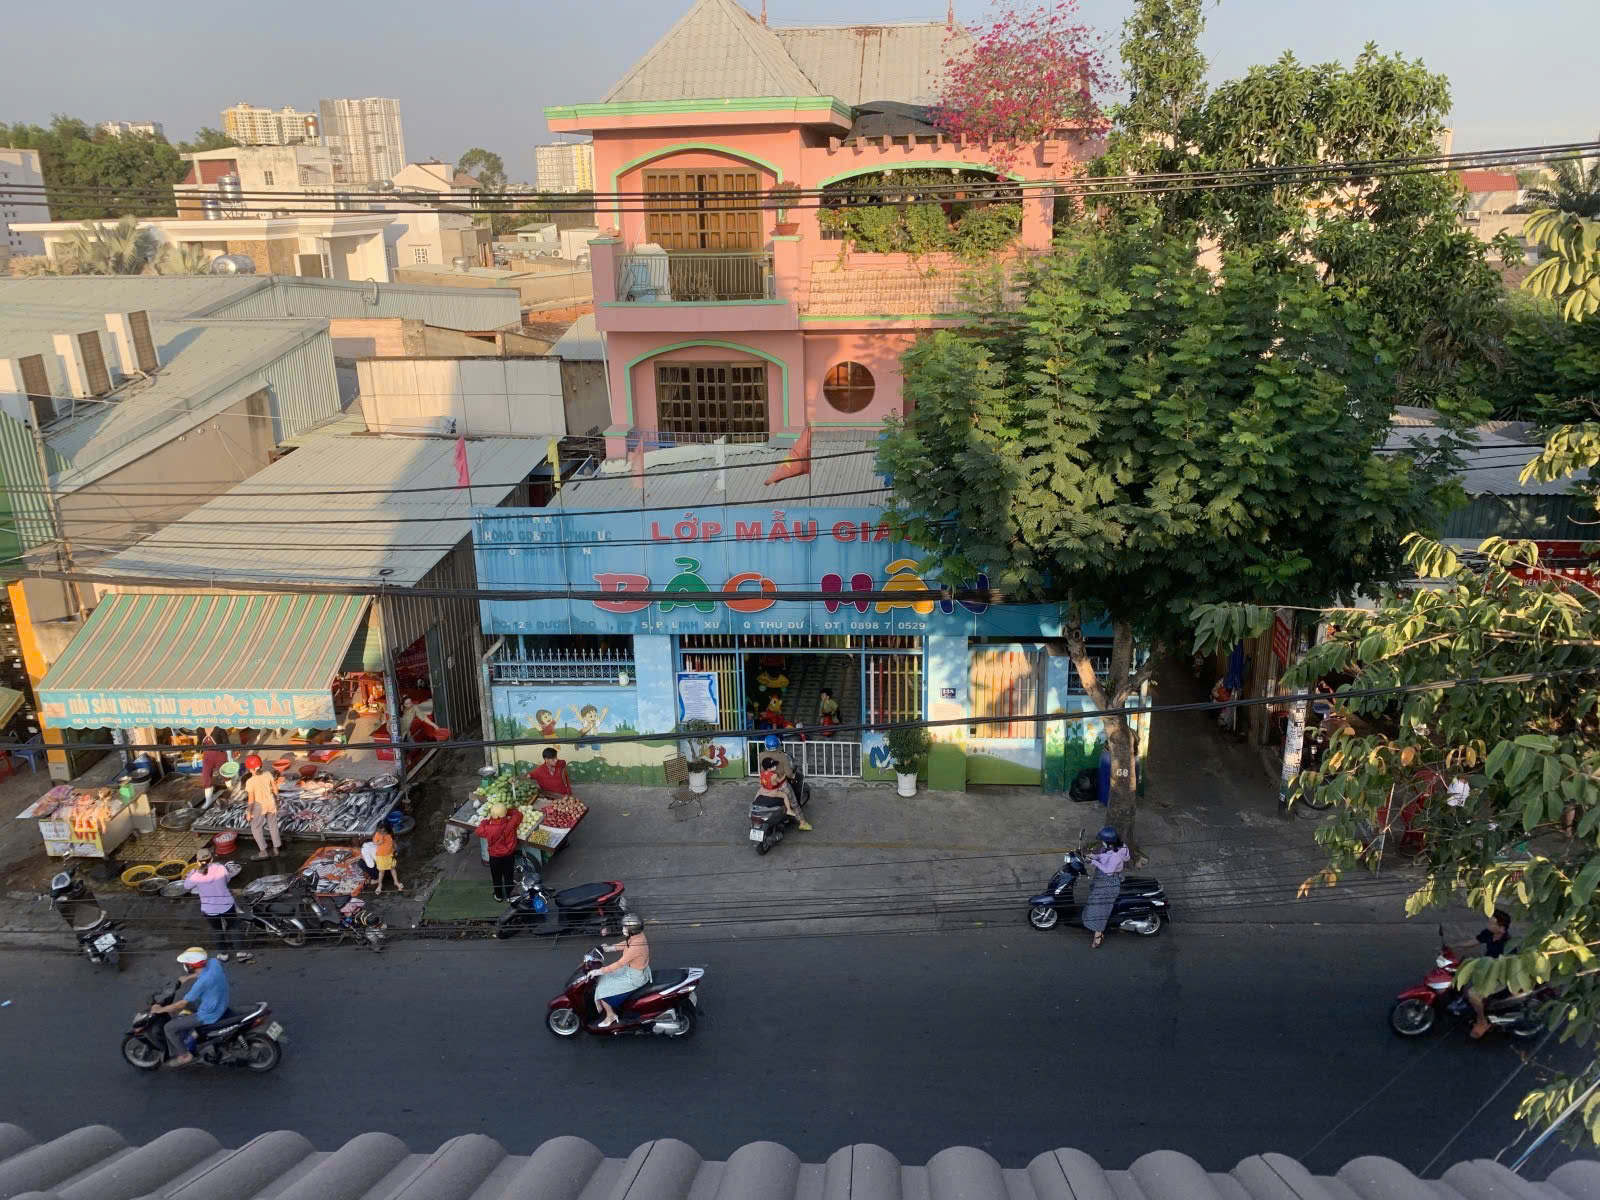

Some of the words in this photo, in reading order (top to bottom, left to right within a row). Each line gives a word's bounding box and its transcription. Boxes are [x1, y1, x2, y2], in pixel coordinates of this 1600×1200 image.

[650, 512, 722, 543] LỚP
[735, 510, 817, 543] MẪU
[591, 556, 779, 614] BẢO
[820, 558, 991, 615] HÂN
[850, 621, 879, 630] 0898
